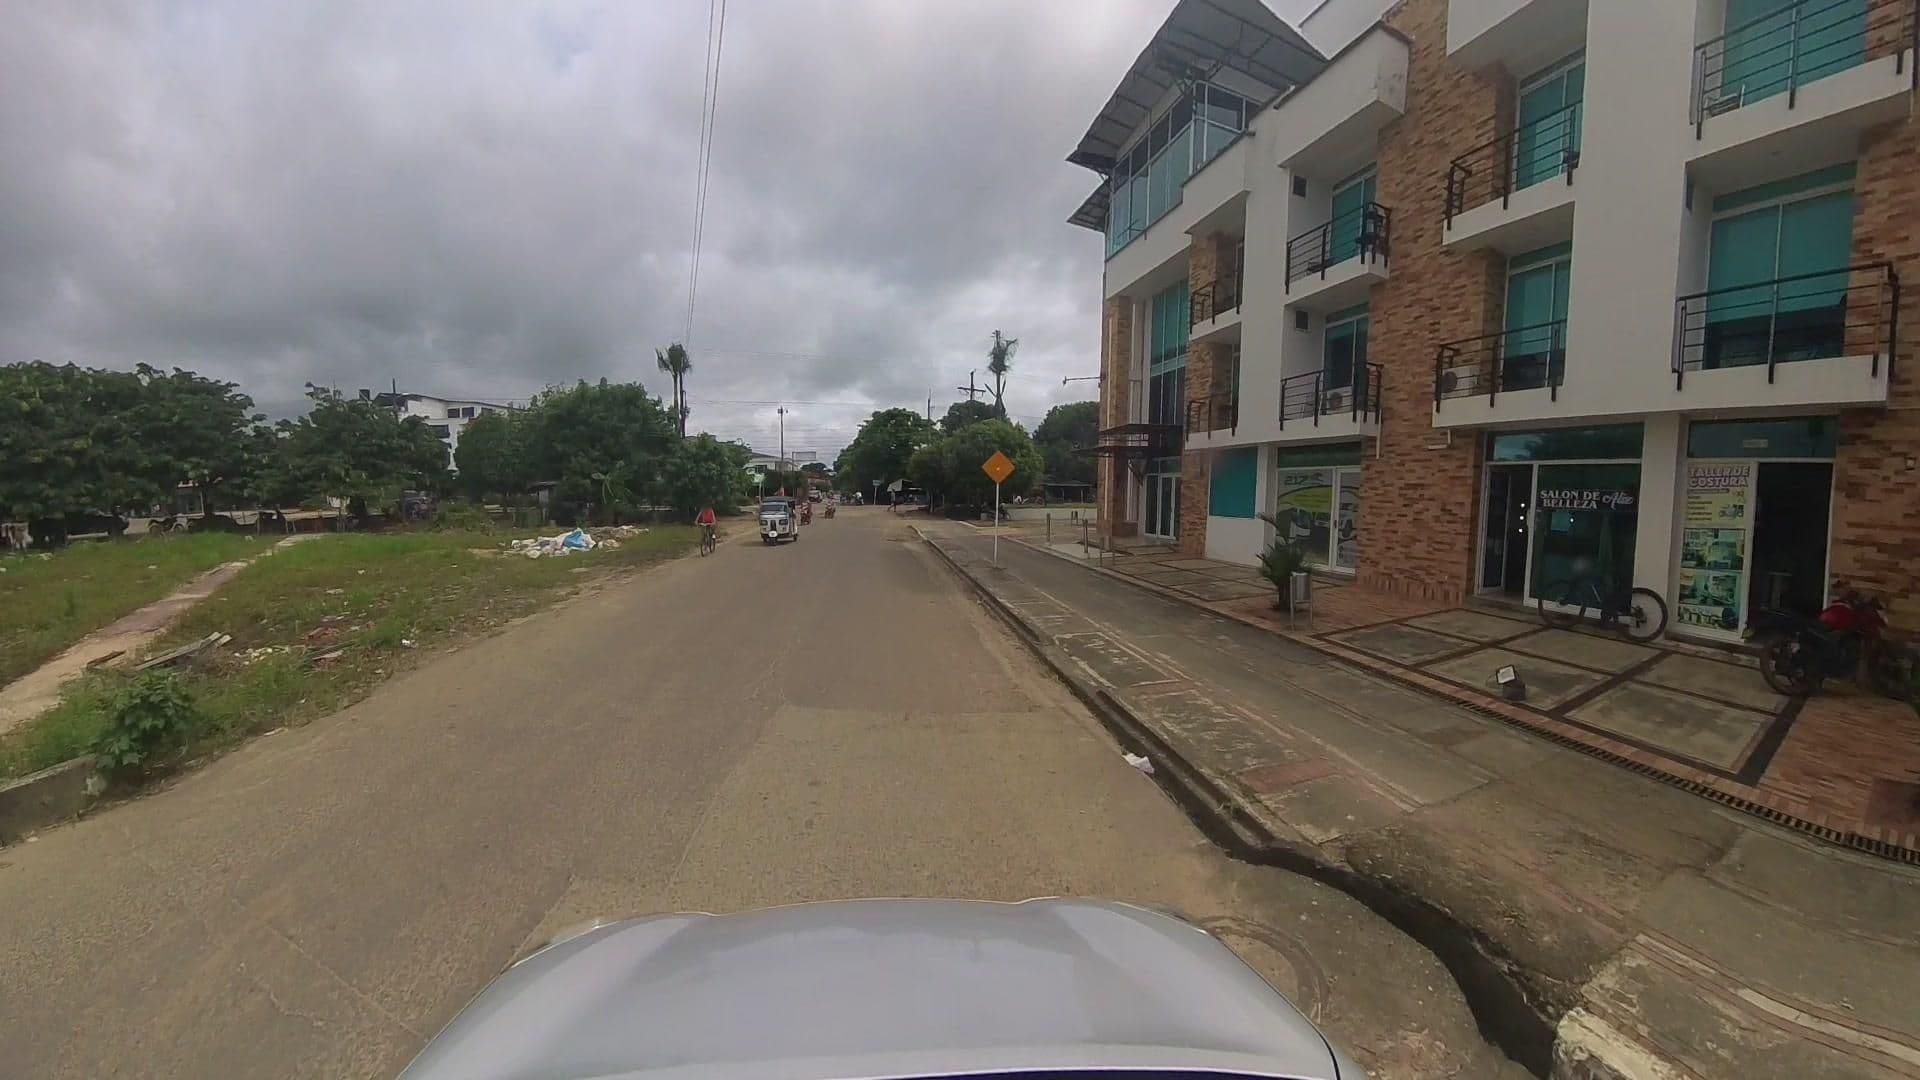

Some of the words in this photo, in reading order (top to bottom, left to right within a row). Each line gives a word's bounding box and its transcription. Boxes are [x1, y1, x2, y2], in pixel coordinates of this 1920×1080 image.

[1689, 466, 1731, 477] TALLER
[1732, 465, 1750, 477] DE
[1688, 477, 1749, 487] COSTURA
[1540, 490, 1579, 499] SALON
[1583, 491, 1601, 501] DE
[1543, 498, 1597, 509] BELLEZA
